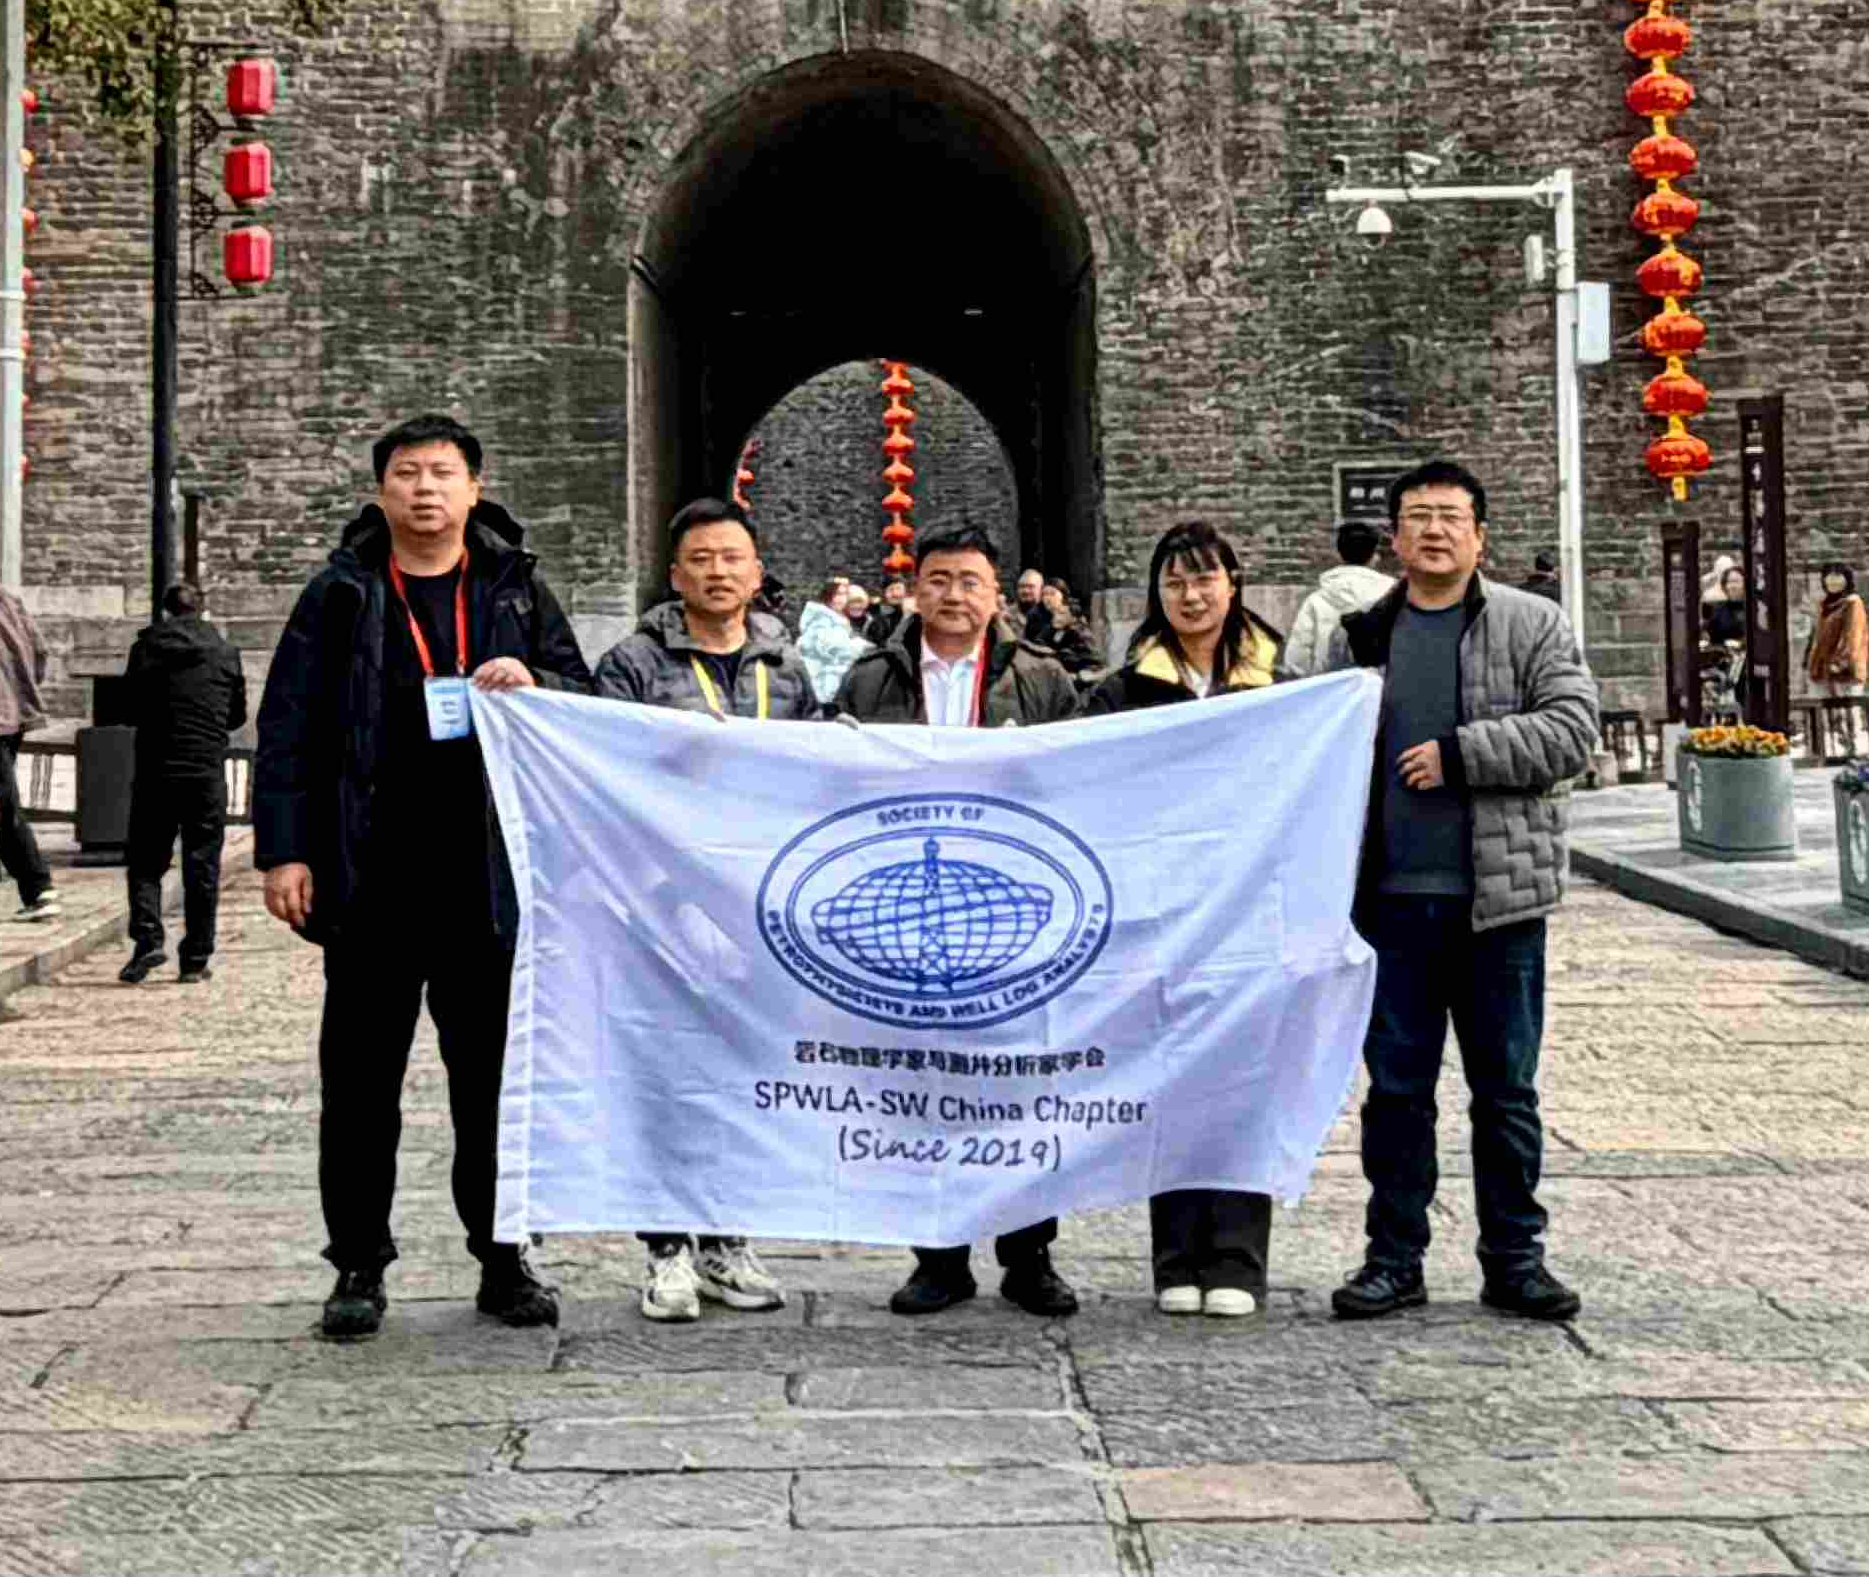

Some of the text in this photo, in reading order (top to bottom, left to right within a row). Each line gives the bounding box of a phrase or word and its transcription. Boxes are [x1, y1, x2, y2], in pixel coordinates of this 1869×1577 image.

[877, 805, 985, 826] SOCIETY OF
[909, 1004, 947, 1019] AND
[951, 1000, 996, 1019] WELL
[1002, 980, 1040, 1008] LOG
[1041, 903, 1105, 984] ANALYSTS
[754, 1080, 1147, 1129] SPWLA-SW China Chapter
[838, 1126, 1062, 1173] (Since 2019)
